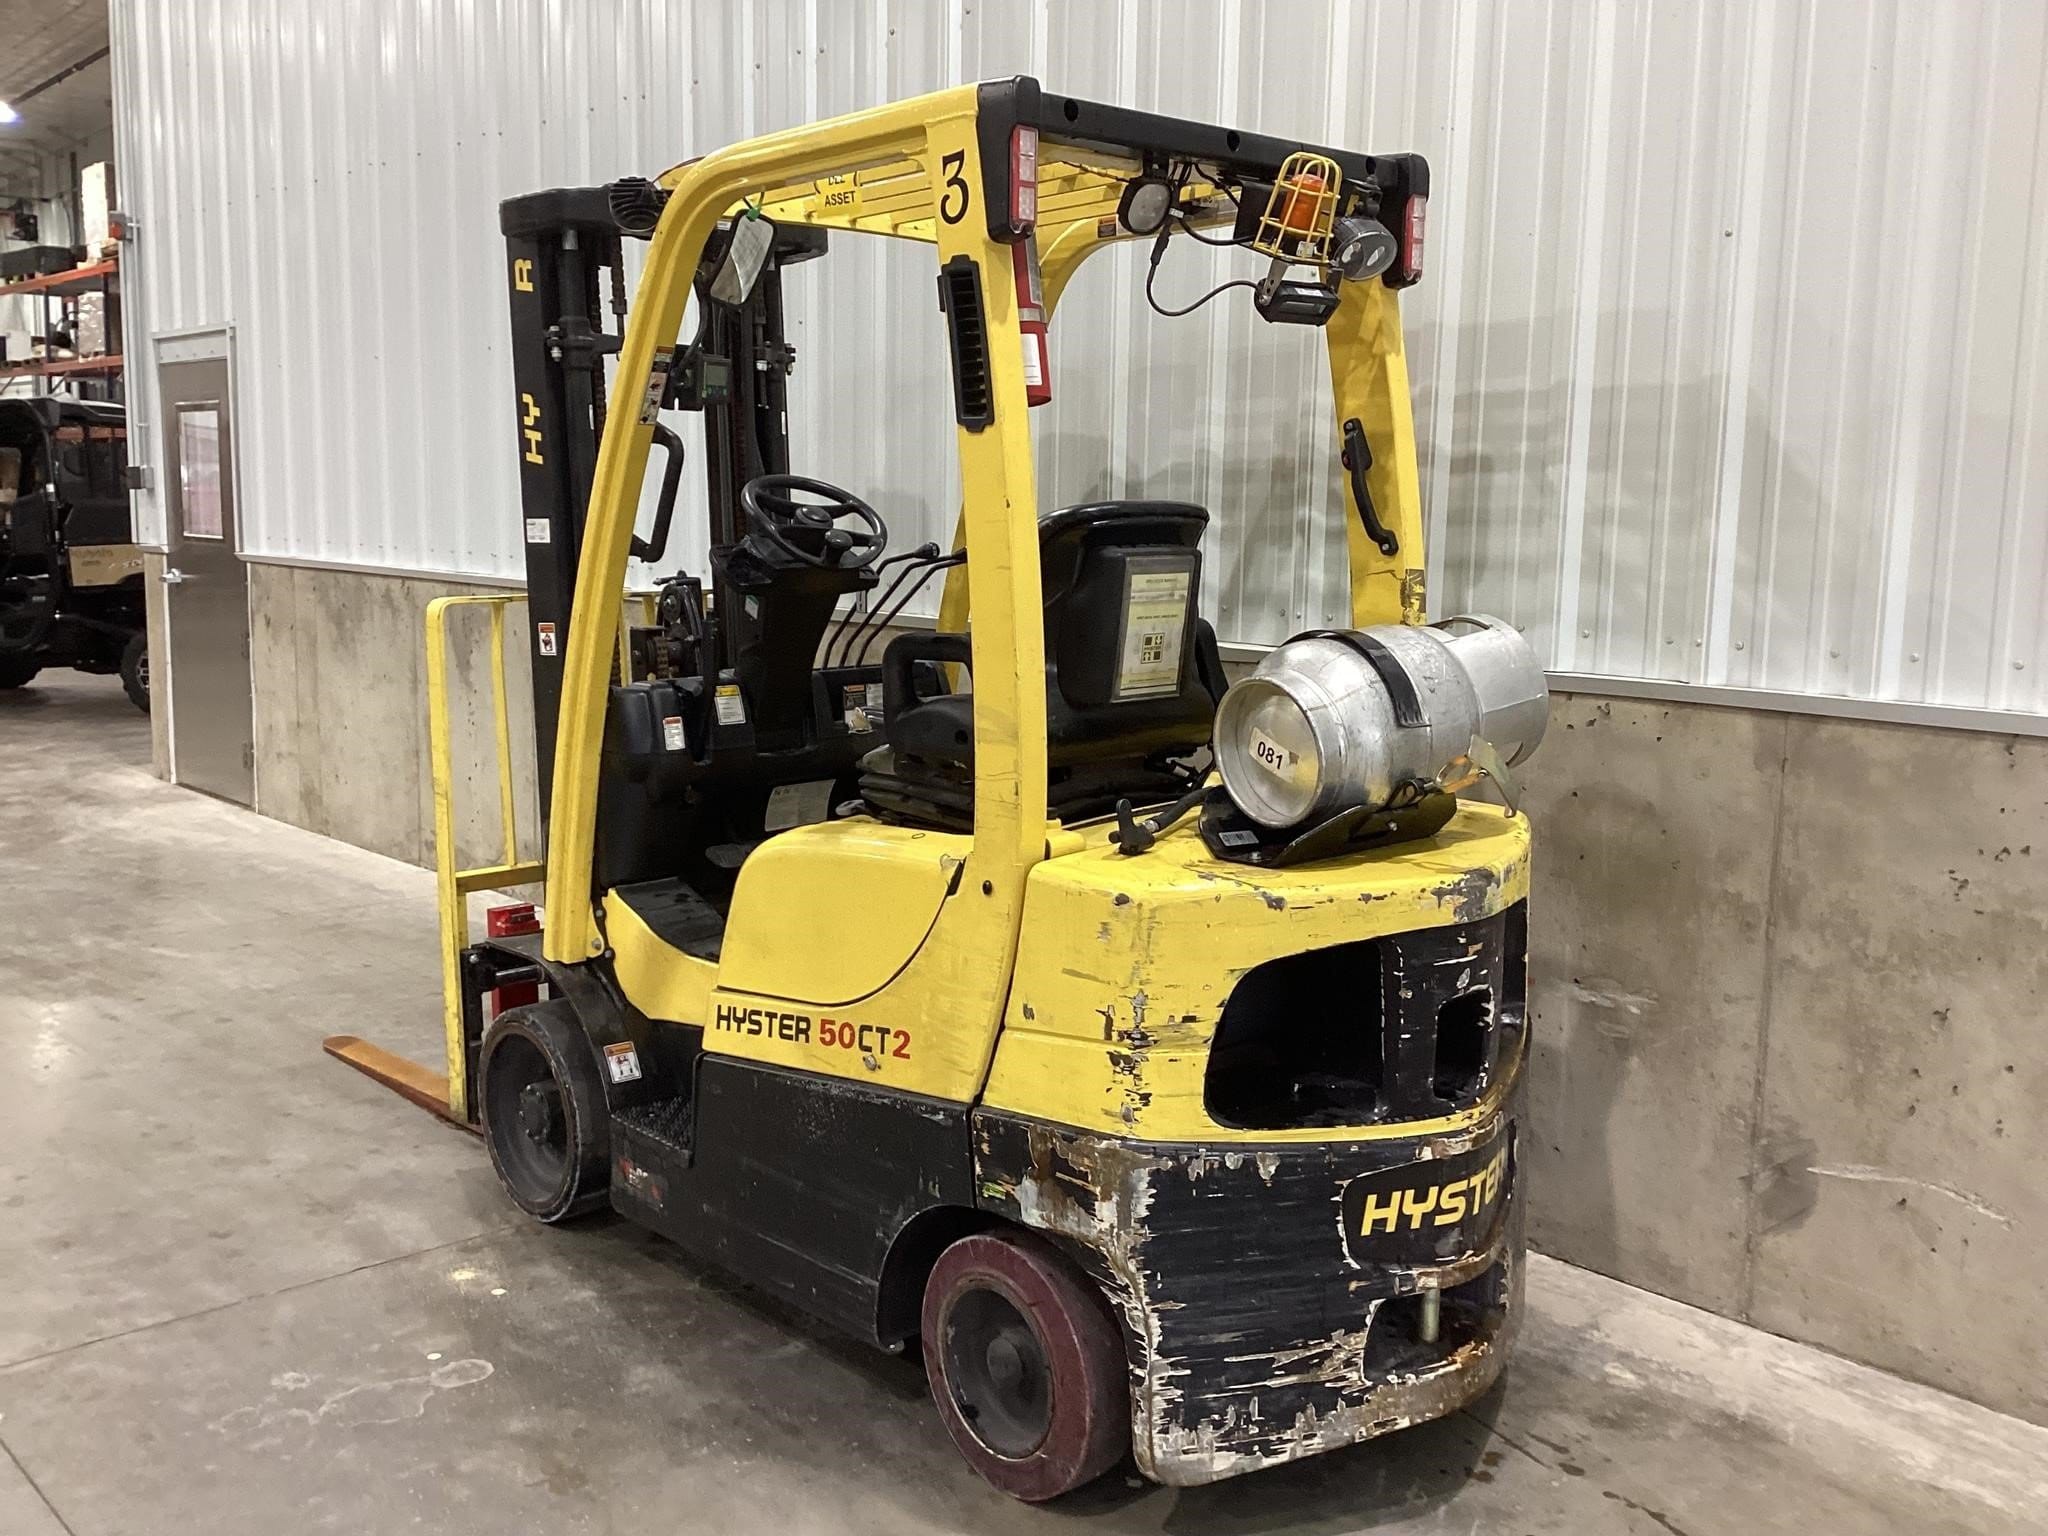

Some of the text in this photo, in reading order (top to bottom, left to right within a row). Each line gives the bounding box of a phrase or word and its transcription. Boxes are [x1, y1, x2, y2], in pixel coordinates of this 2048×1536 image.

[824, 190, 856, 208] ASSET
[941, 148, 969, 225] 3
[1257, 741, 1284, 770] 081
[715, 1004, 912, 1060] HYSTER 50CT2
